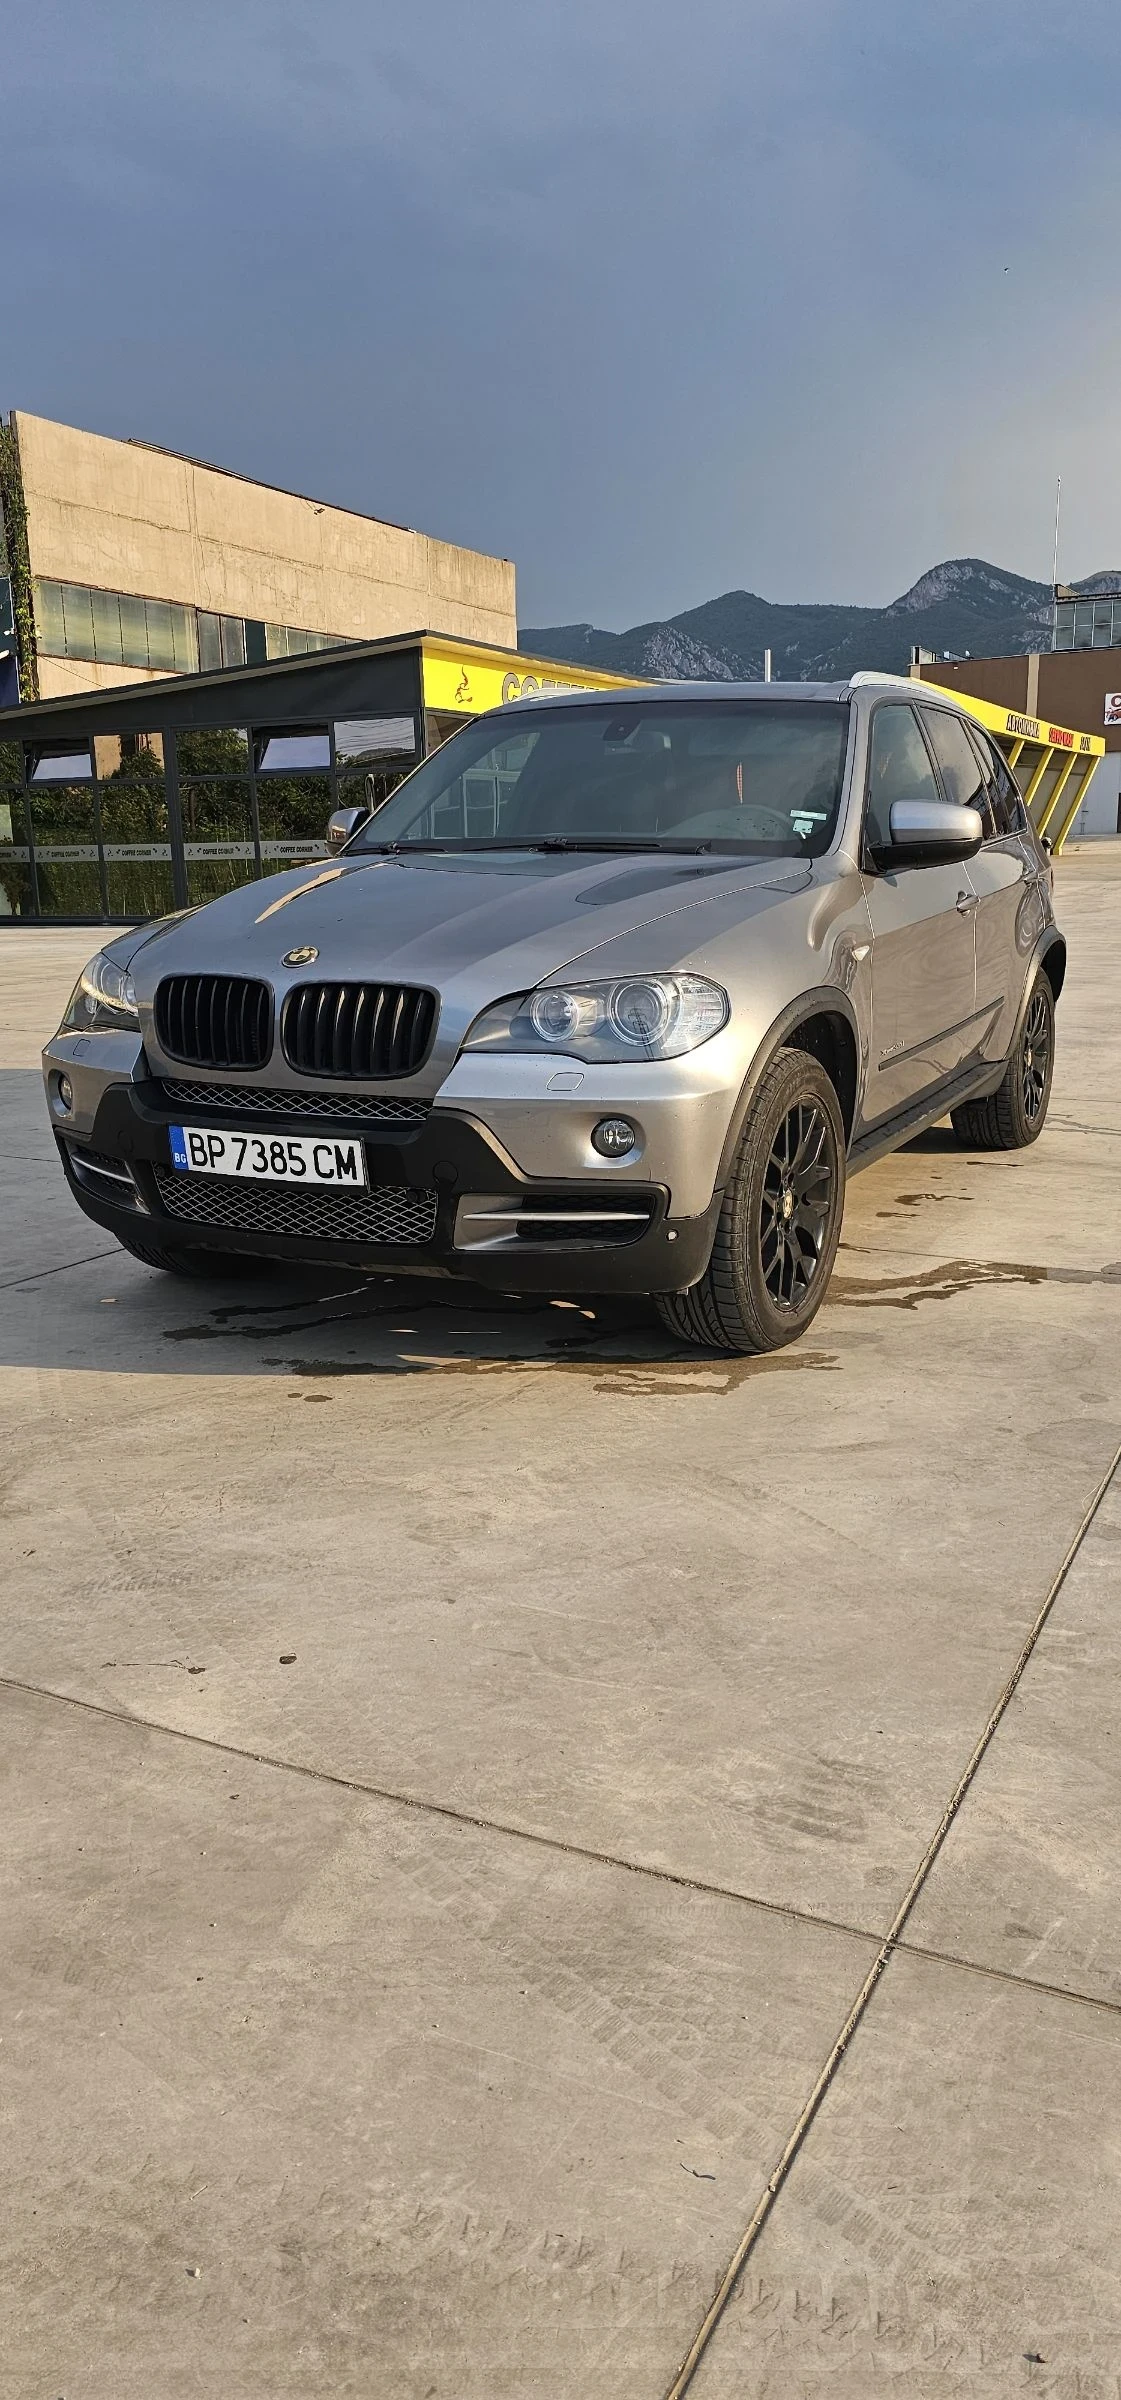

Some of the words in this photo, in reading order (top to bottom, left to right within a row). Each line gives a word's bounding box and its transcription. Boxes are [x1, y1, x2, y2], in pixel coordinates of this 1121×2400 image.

[174, 1152, 187, 1163] BG
[188, 1133, 225, 1168] BP
[231, 1137, 306, 1176] 7385
[313, 1144, 357, 1180] CM
